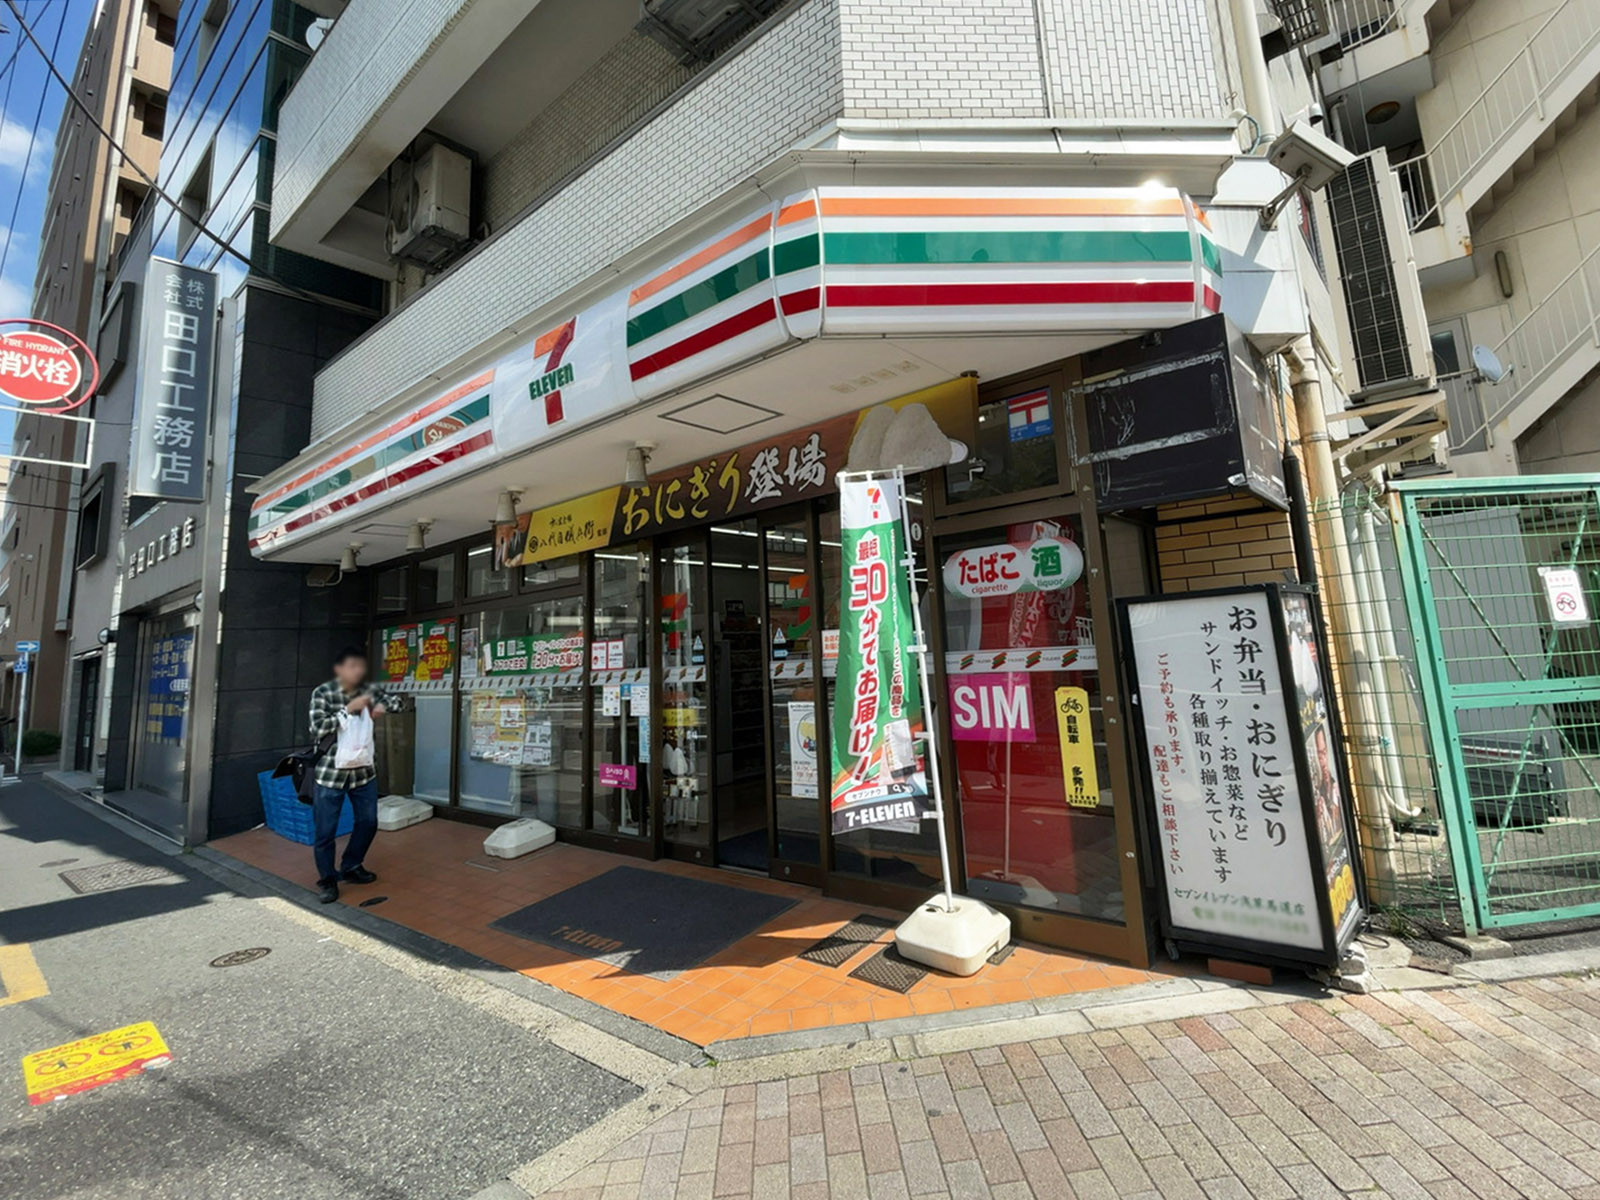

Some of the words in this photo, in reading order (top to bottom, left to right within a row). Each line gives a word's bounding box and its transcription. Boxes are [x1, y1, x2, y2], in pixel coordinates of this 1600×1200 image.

[3, 337, 23, 349] FIRE
[25, 341, 66, 355] HYDRANT
[0, 350, 72, 386] 消火栓
[151, 310, 199, 485] 田口工務店
[622, 432, 828, 536] おにぎり登場
[958, 551, 1020, 586] たばこ
[1031, 544, 1062, 578] 酒
[971, 583, 1009, 595] cigarette
[1037, 578, 1064, 588] liquor
[953, 685, 1031, 730] SIM
[1157, 653, 1187, 775] ご予約も承ります。
[1227, 606, 1288, 848] お弁当・おにぎり
[1066, 714, 1080, 744] 自転車
[1200, 621, 1250, 842] サンドイッチ・お惣菜など
[852, 788, 882, 800] セブンナウ
[1189, 693, 1233, 885] 各種取り揃えています
[1152, 744, 1185, 876] 配達もご相談下さい
